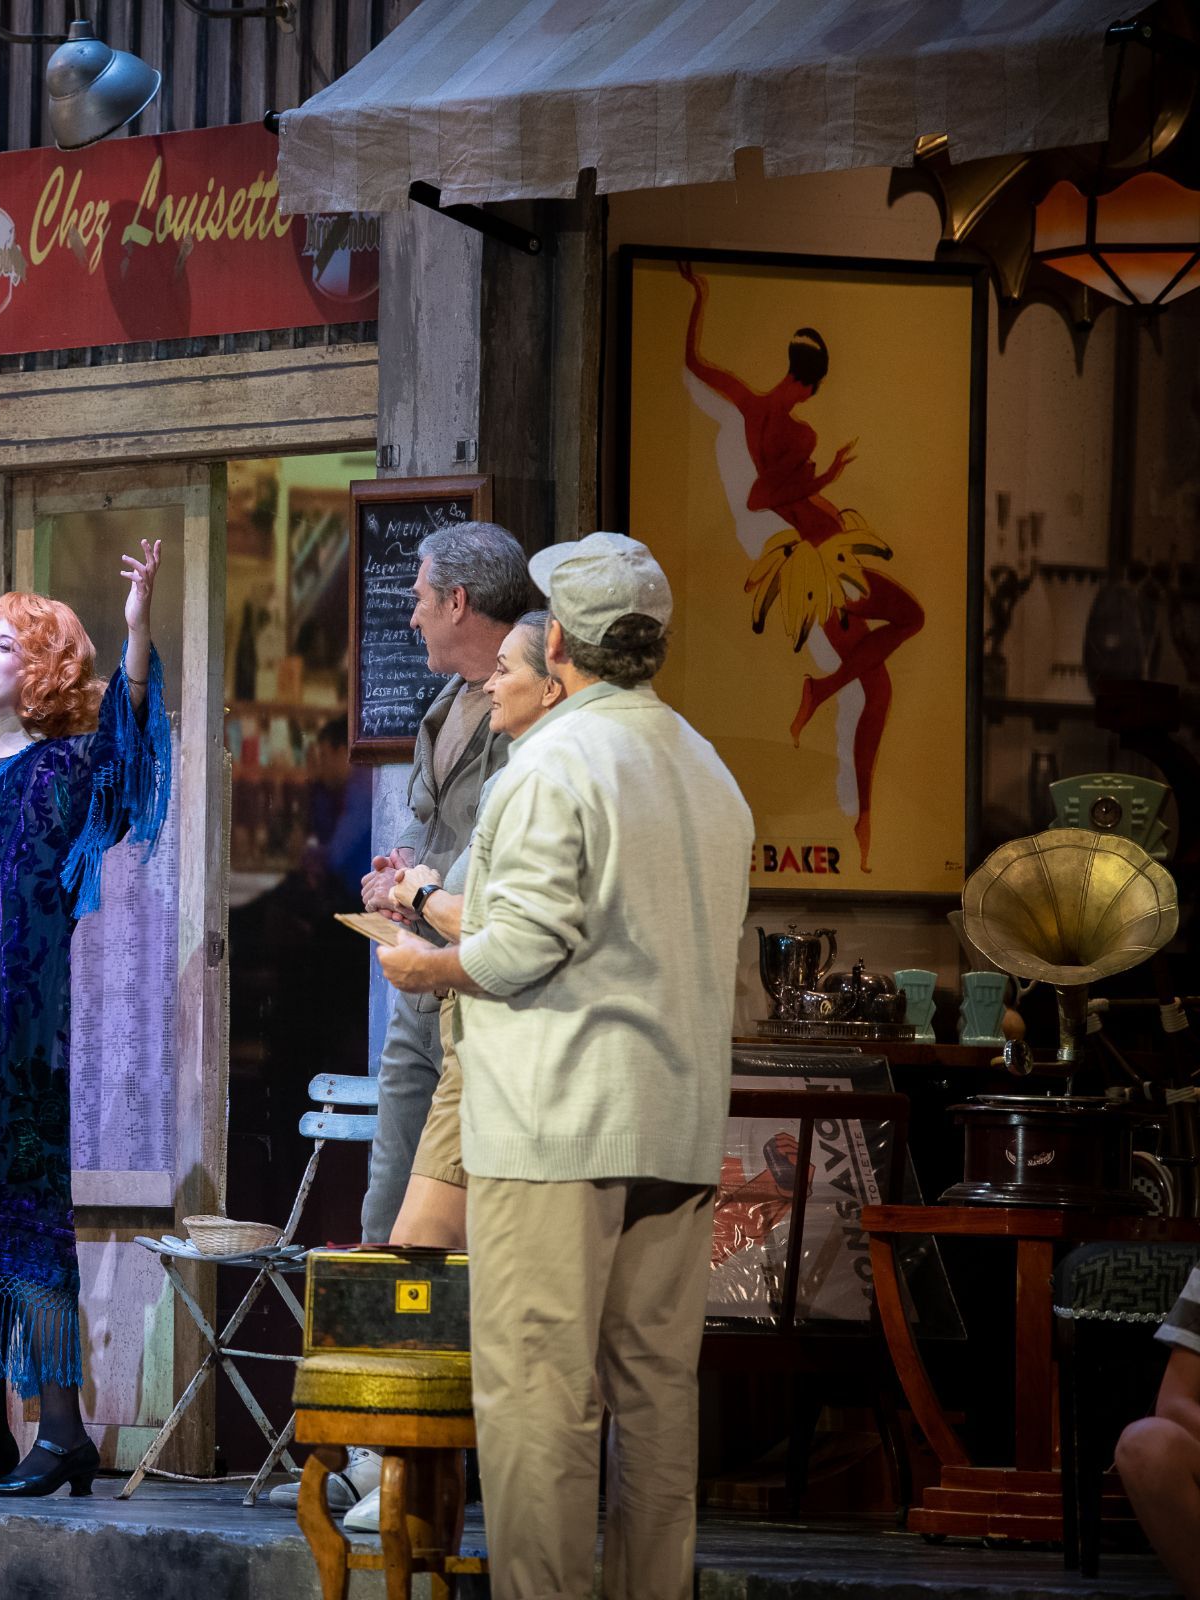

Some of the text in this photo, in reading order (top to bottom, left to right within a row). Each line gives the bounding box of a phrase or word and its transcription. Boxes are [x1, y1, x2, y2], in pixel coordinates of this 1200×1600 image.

[30, 165, 112, 275] Chez
[449, 502, 467, 520] Bon
[763, 844, 841, 875] BAKER
[854, 1131, 877, 1202] TOILETTE
